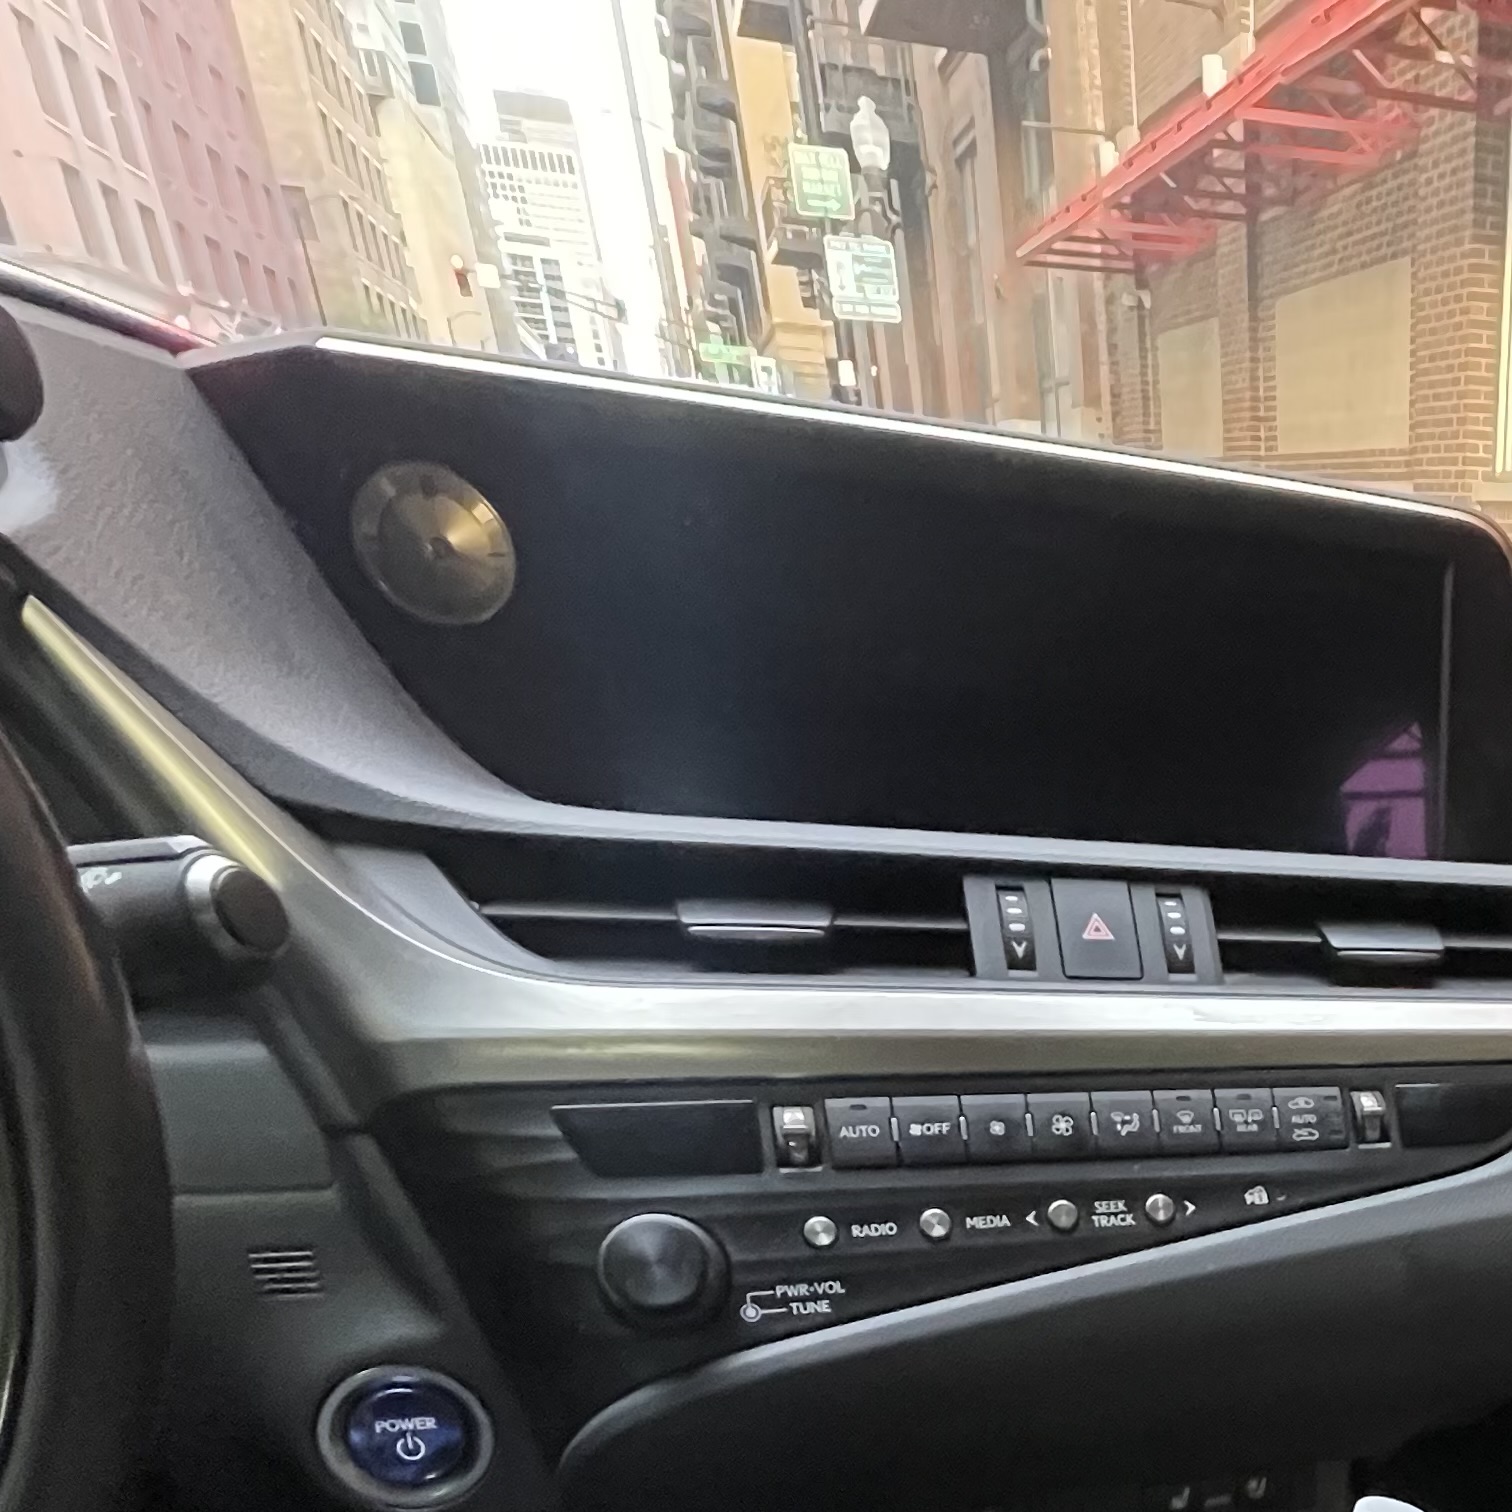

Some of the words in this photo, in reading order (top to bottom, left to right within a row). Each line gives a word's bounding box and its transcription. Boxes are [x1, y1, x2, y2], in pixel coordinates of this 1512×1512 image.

[839, 1124, 880, 1139] AUTO
[922, 1122, 951, 1136] OFF
[1094, 1200, 1128, 1214] SEEK
[965, 1214, 1012, 1229] MEDIA
[1091, 1213, 1137, 1228] TRACK
[851, 1222, 898, 1238] RADIO
[789, 1300, 832, 1315] TUNE
[374, 1416, 438, 1434] POWER
